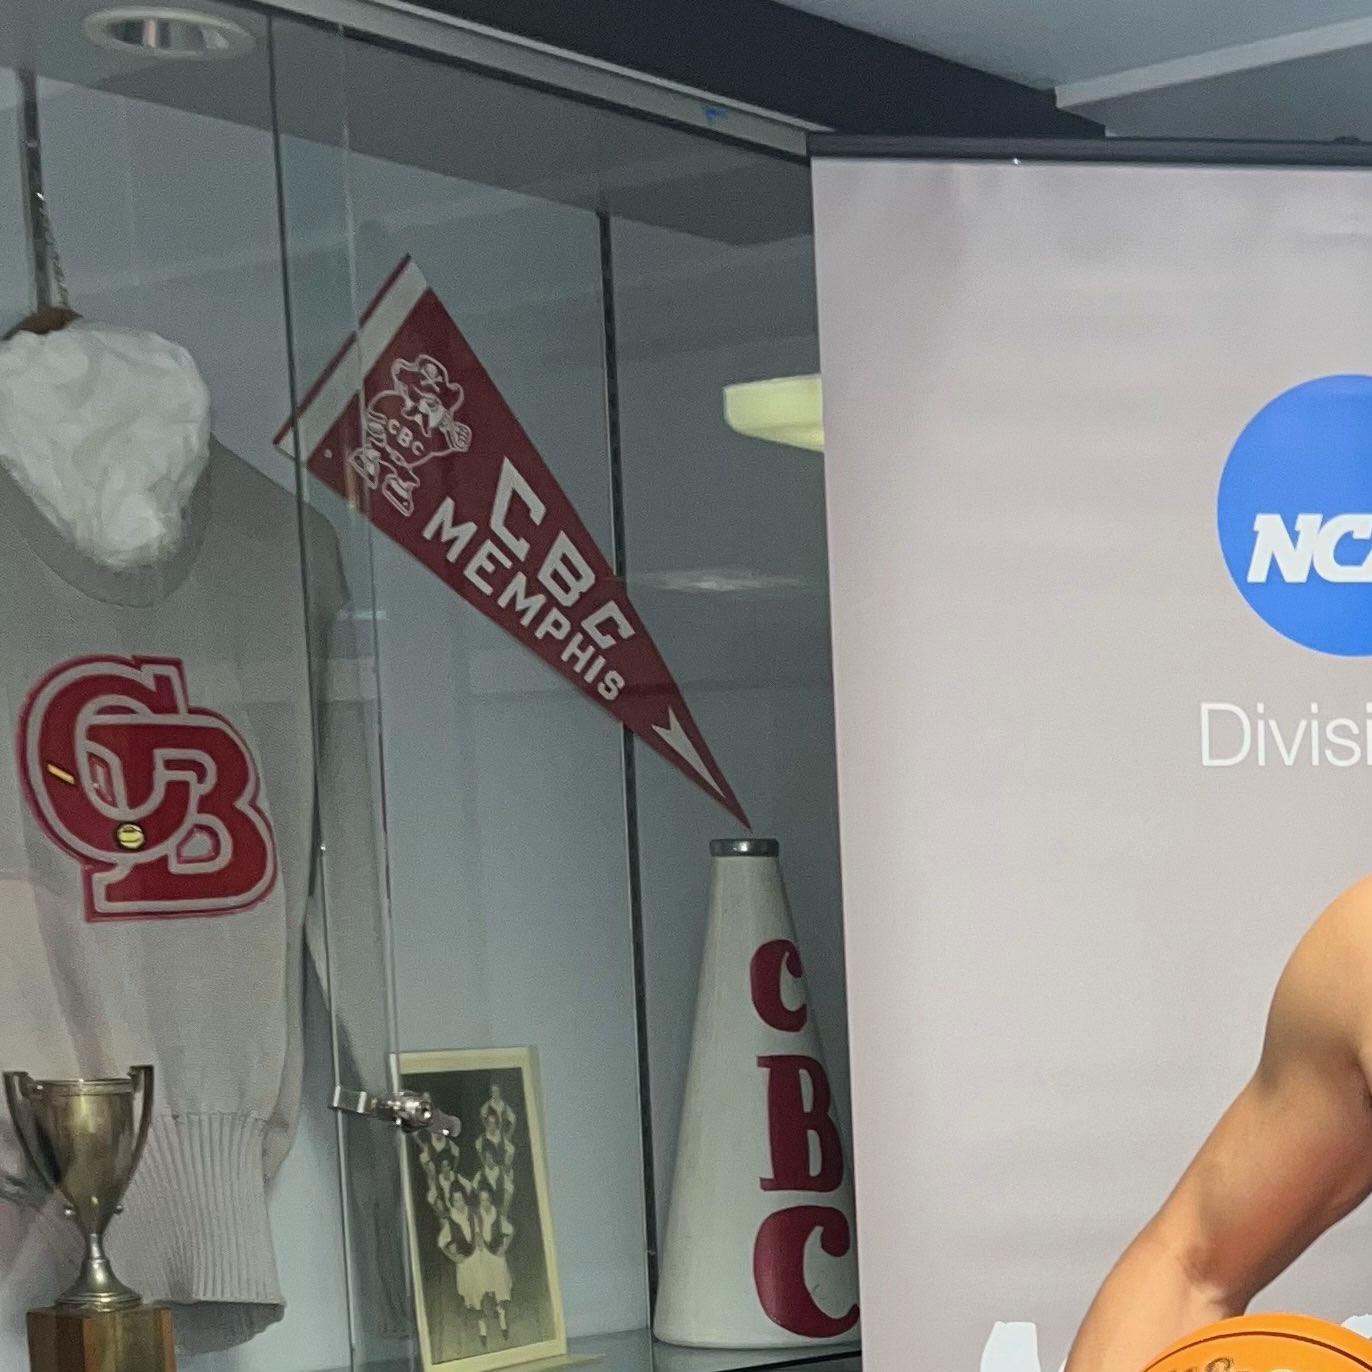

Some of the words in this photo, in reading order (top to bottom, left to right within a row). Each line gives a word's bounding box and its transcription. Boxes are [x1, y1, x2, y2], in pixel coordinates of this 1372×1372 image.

[386, 418, 425, 456] CBC
[421, 496, 626, 700] MEMPHIS
[489, 455, 636, 650] CBC
